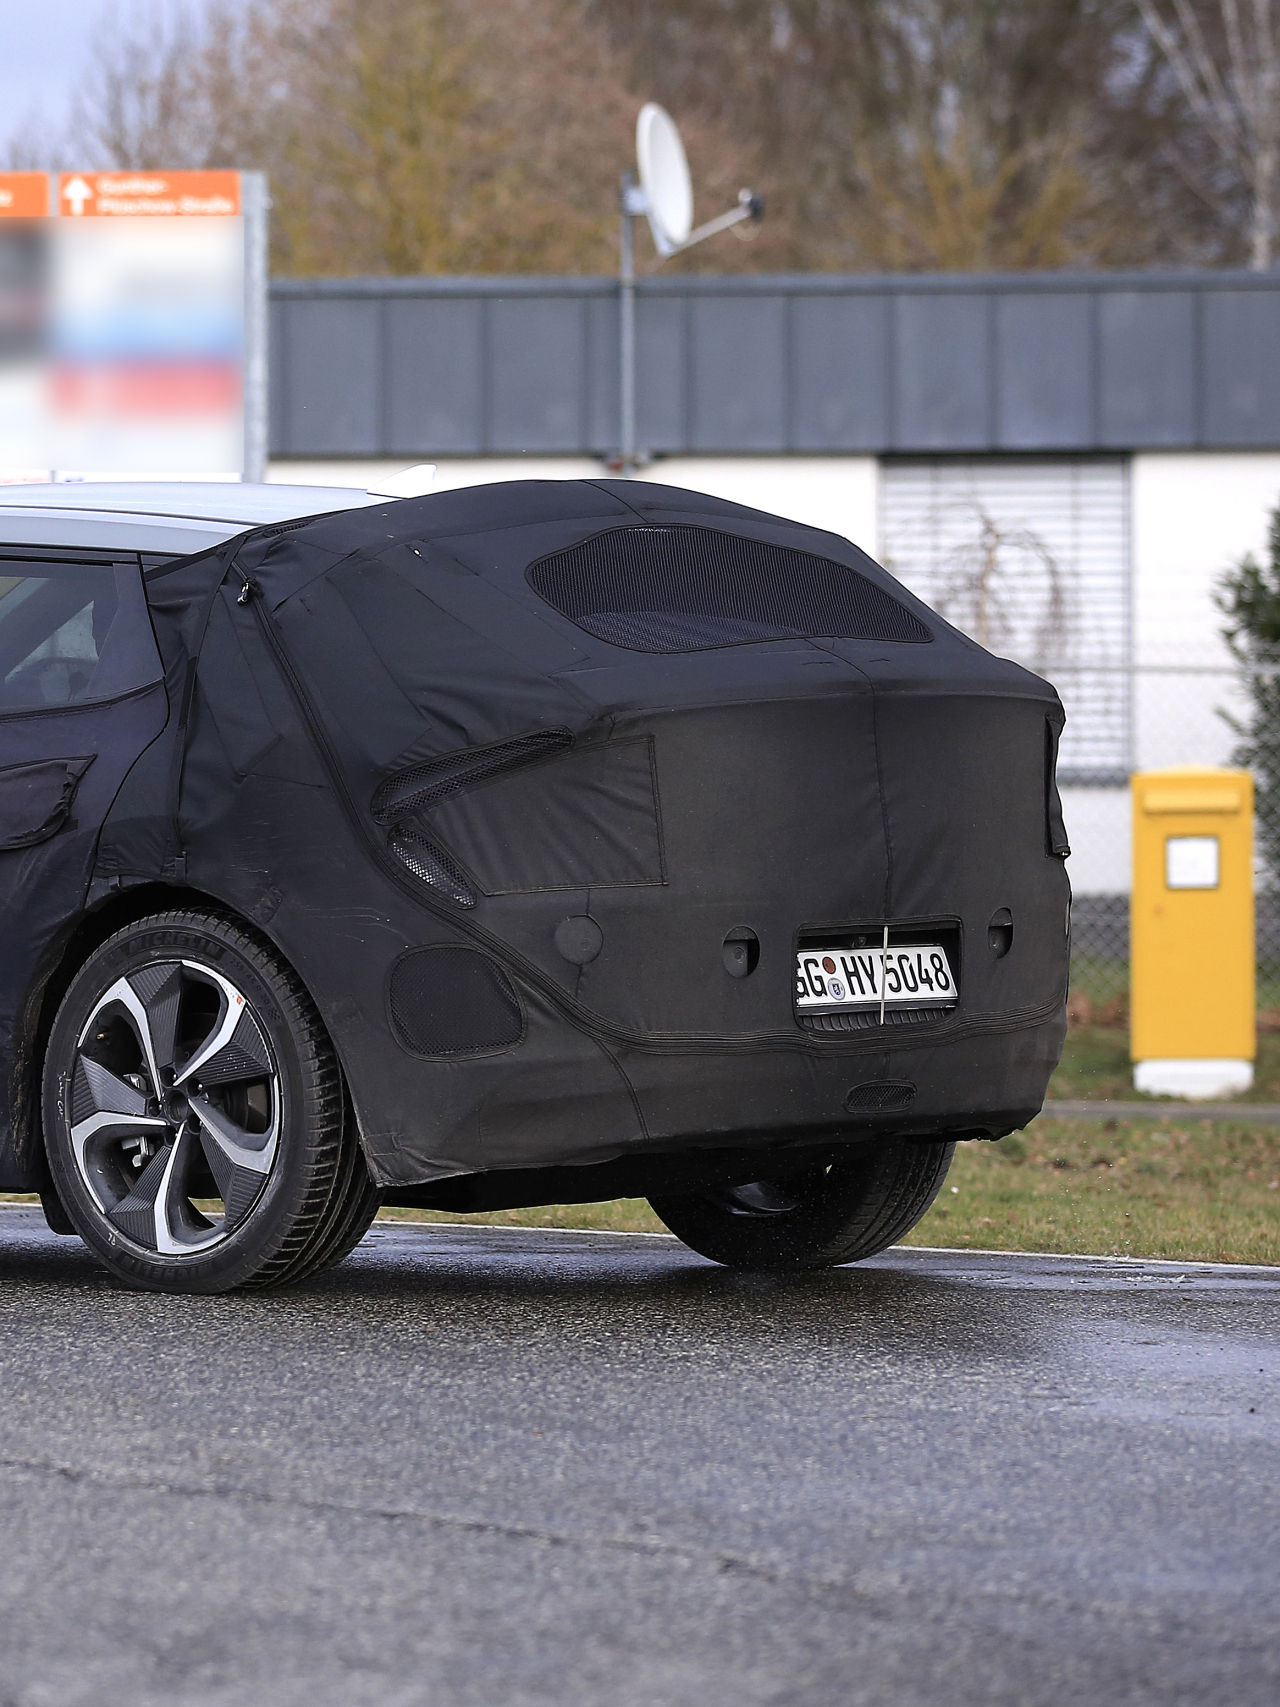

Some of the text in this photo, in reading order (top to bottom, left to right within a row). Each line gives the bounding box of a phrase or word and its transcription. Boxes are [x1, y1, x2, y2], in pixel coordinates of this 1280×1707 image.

[129, 931, 222, 958] MICHELIN
[840, 955, 877, 996] HY
[880, 953, 950, 992] 5048
